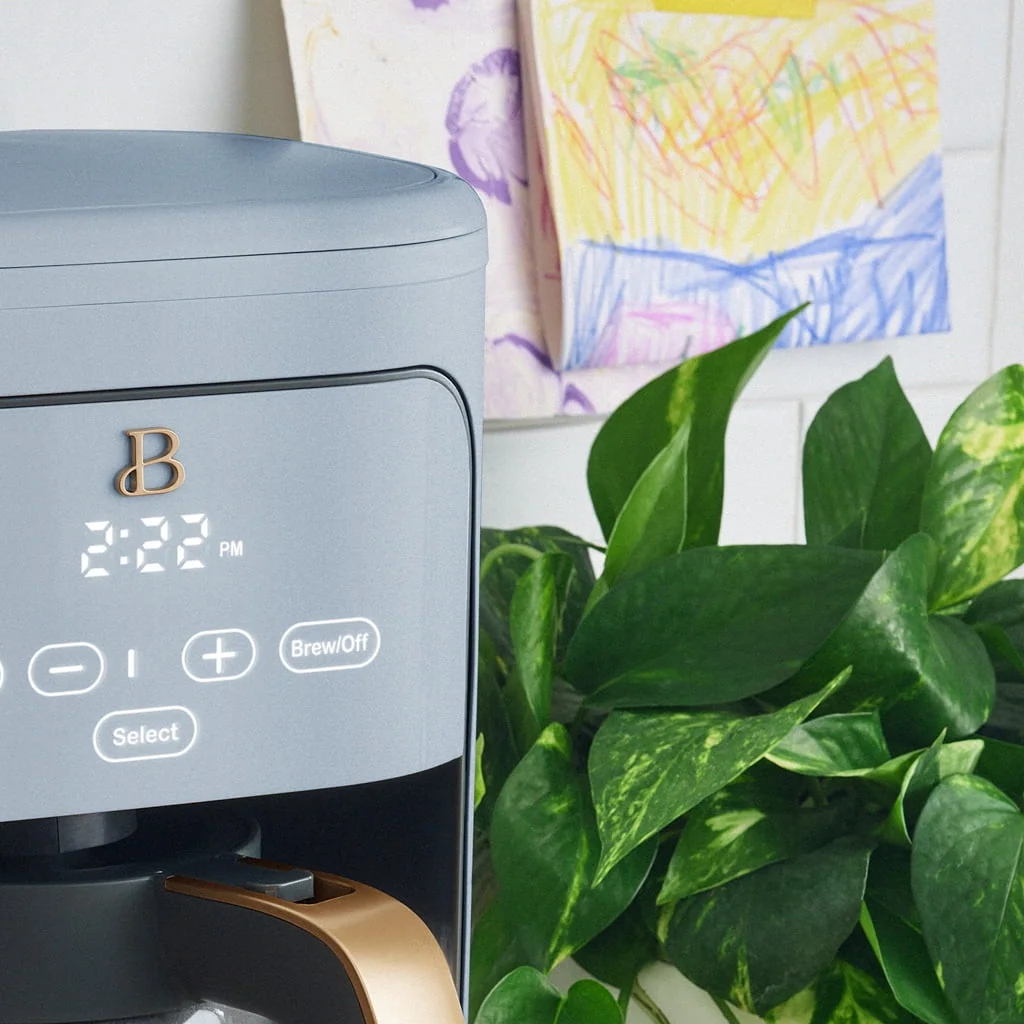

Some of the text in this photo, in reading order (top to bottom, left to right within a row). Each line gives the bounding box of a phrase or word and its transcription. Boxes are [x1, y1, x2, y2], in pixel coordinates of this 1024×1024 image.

[80, 513, 244, 577] 2:22 PM
[291, 633, 369, 659] Brew/Off
[113, 721, 180, 747] Select
